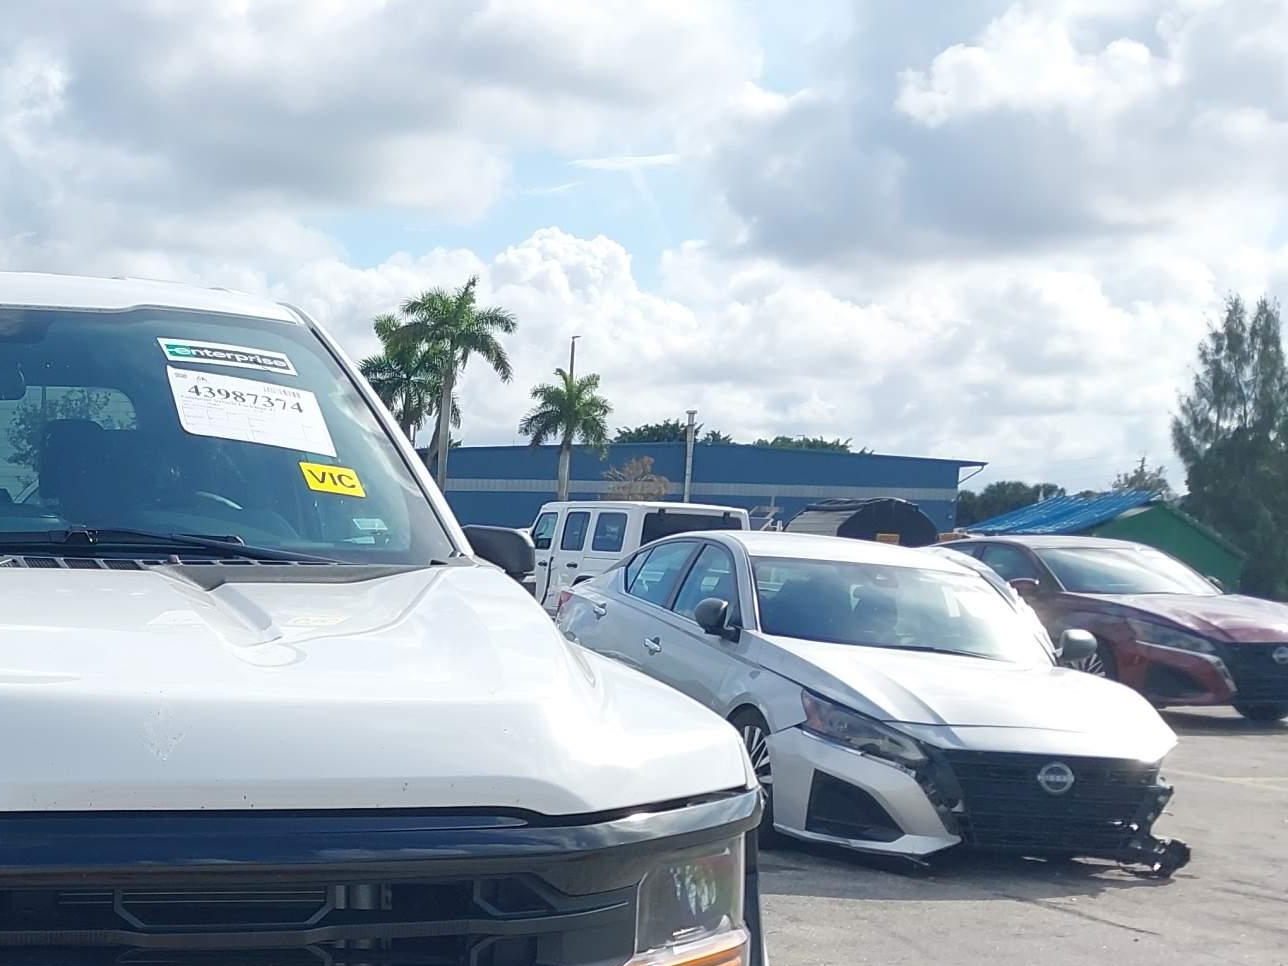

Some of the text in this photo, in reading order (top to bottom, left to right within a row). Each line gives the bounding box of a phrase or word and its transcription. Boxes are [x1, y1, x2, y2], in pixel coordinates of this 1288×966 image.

[171, 346, 289, 369] enterprise
[187, 384, 305, 414] 43987374
[306, 468, 357, 489] VIC
